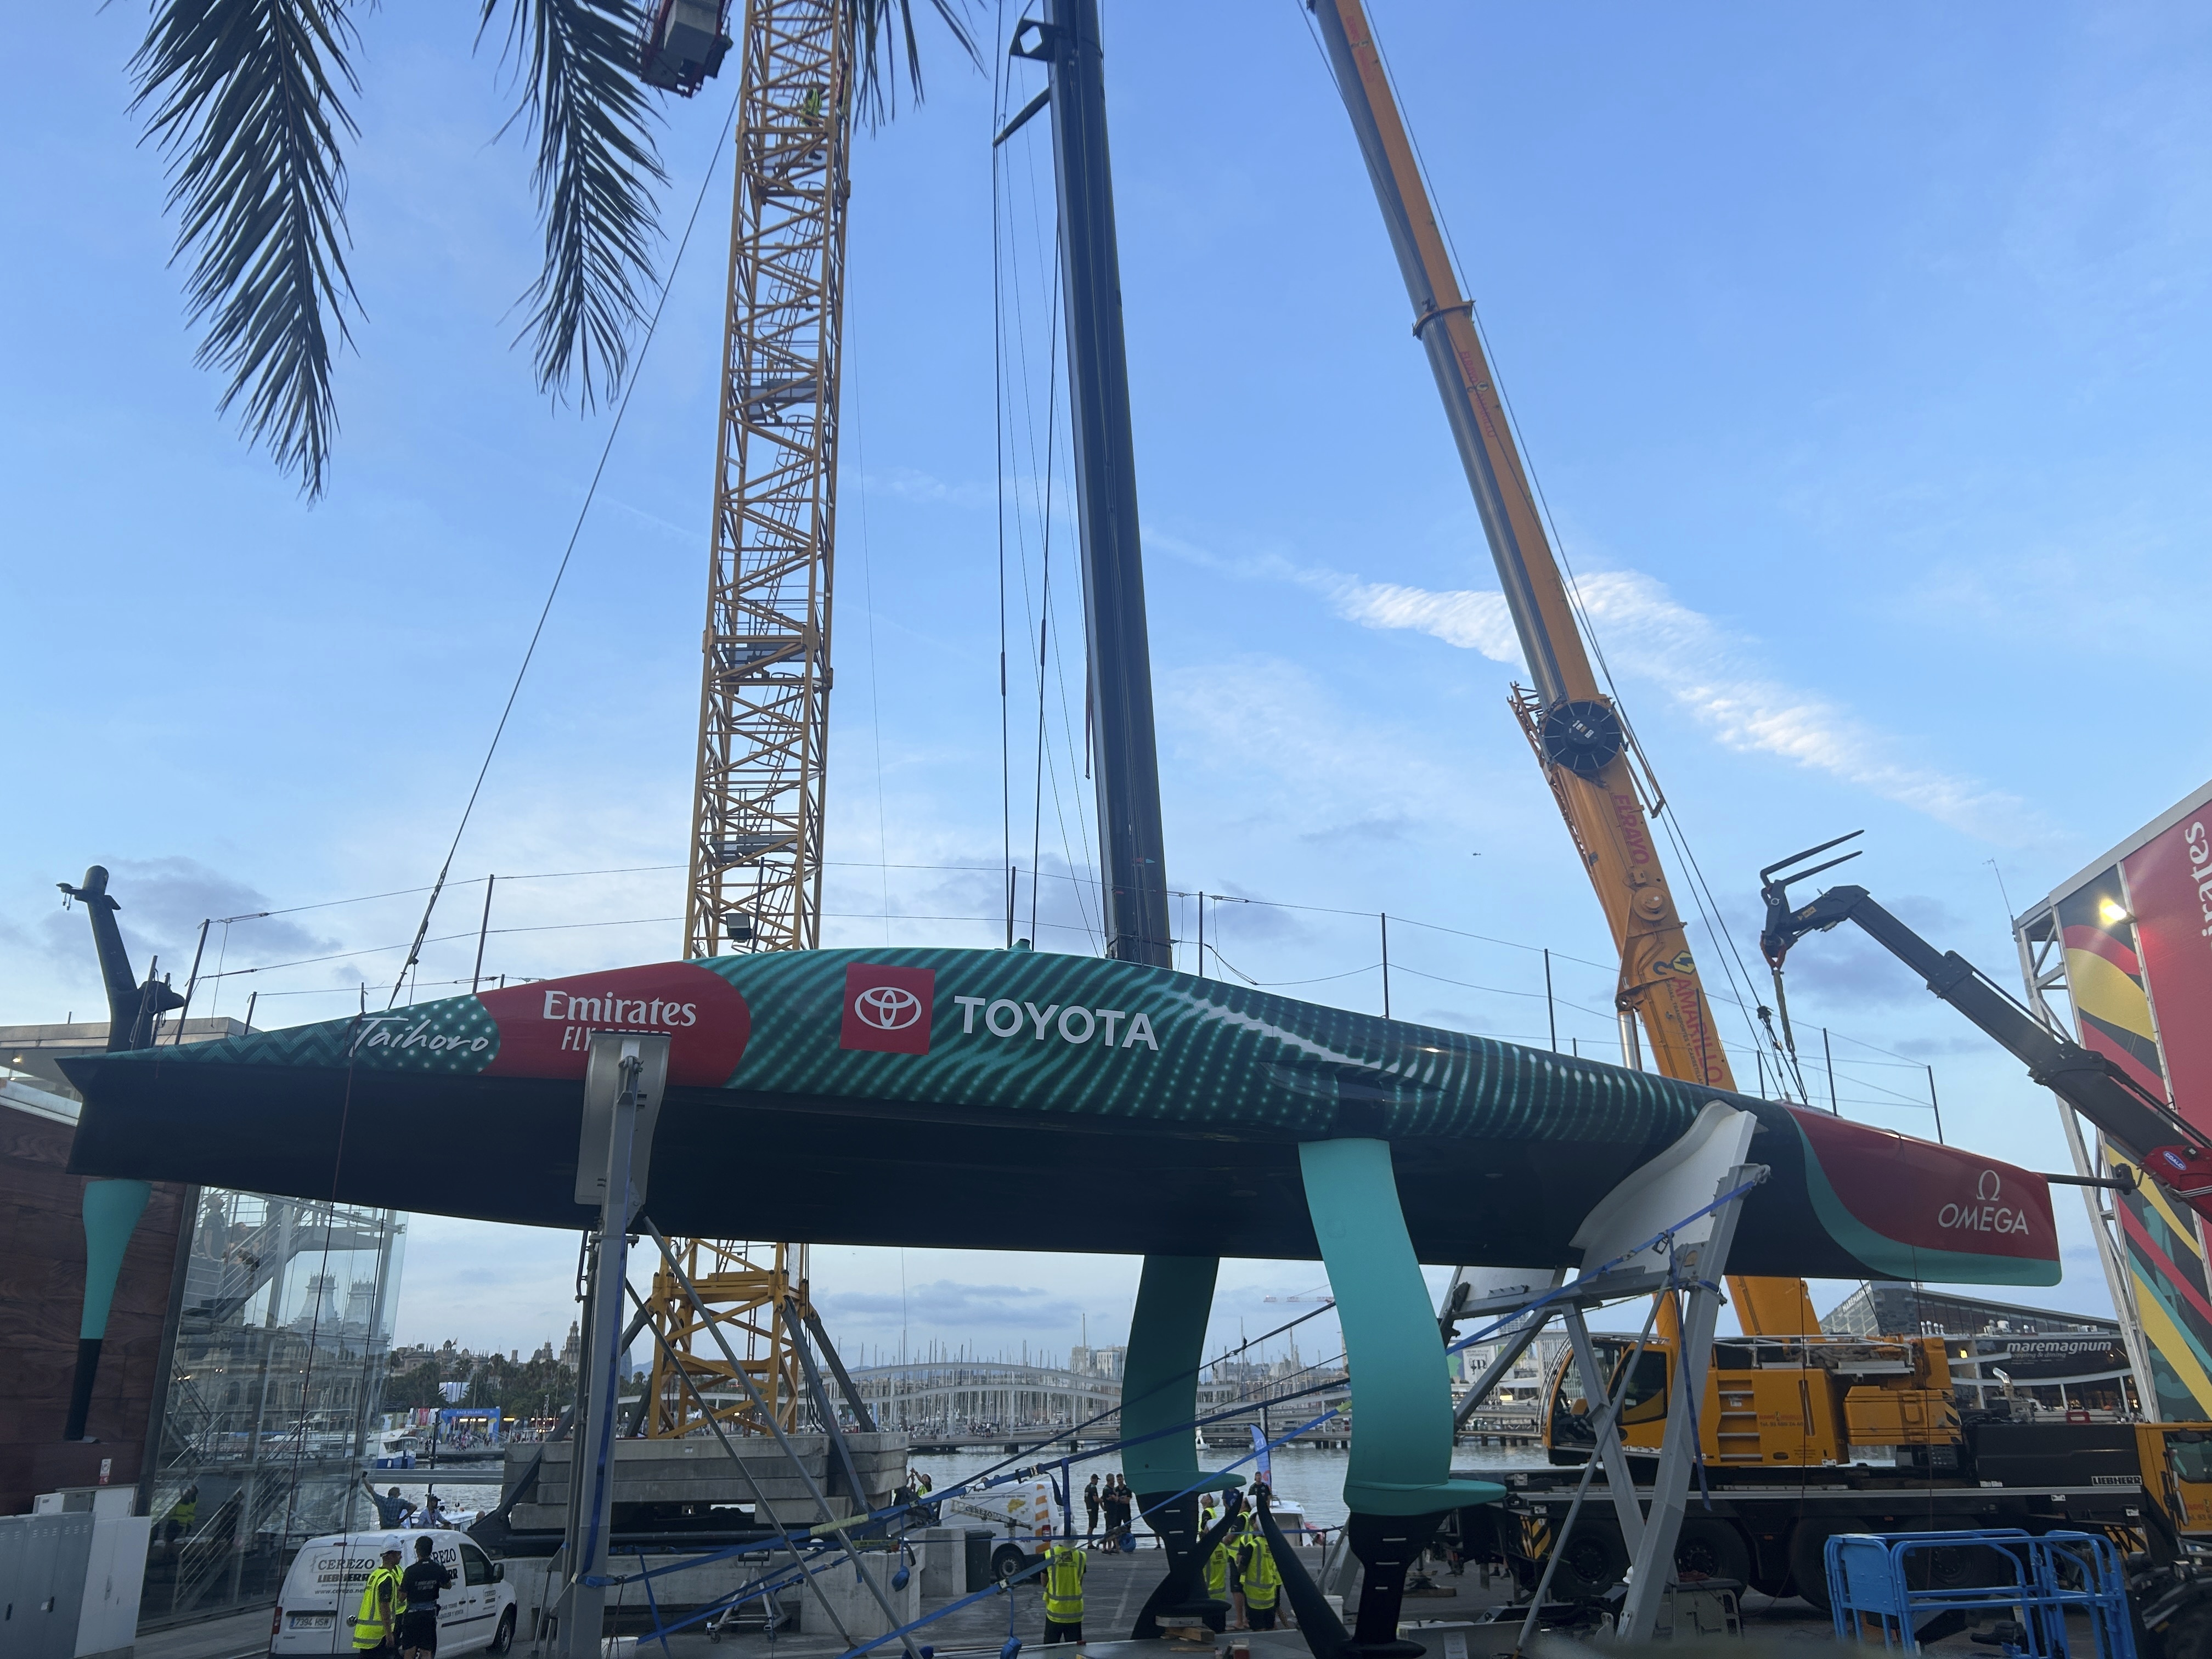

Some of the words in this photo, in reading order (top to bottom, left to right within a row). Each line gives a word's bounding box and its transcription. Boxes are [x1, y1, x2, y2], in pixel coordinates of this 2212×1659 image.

[543, 990, 696, 1026] Emirates
[954, 995, 1159, 1051] TOYOTA
[348, 1017, 489, 1057] Taihoro
[1938, 1203, 2029, 1235] OMEGA
[2006, 1341, 2112, 1355] maremagnum
[2092, 1477, 2142, 1485] LIEBHERR
[966, 1506, 992, 1517] CEREZO
[430, 1548, 456, 1564] REZO
[318, 1559, 375, 1570] CEREZO
[296, 1618, 312, 1626] 7394
